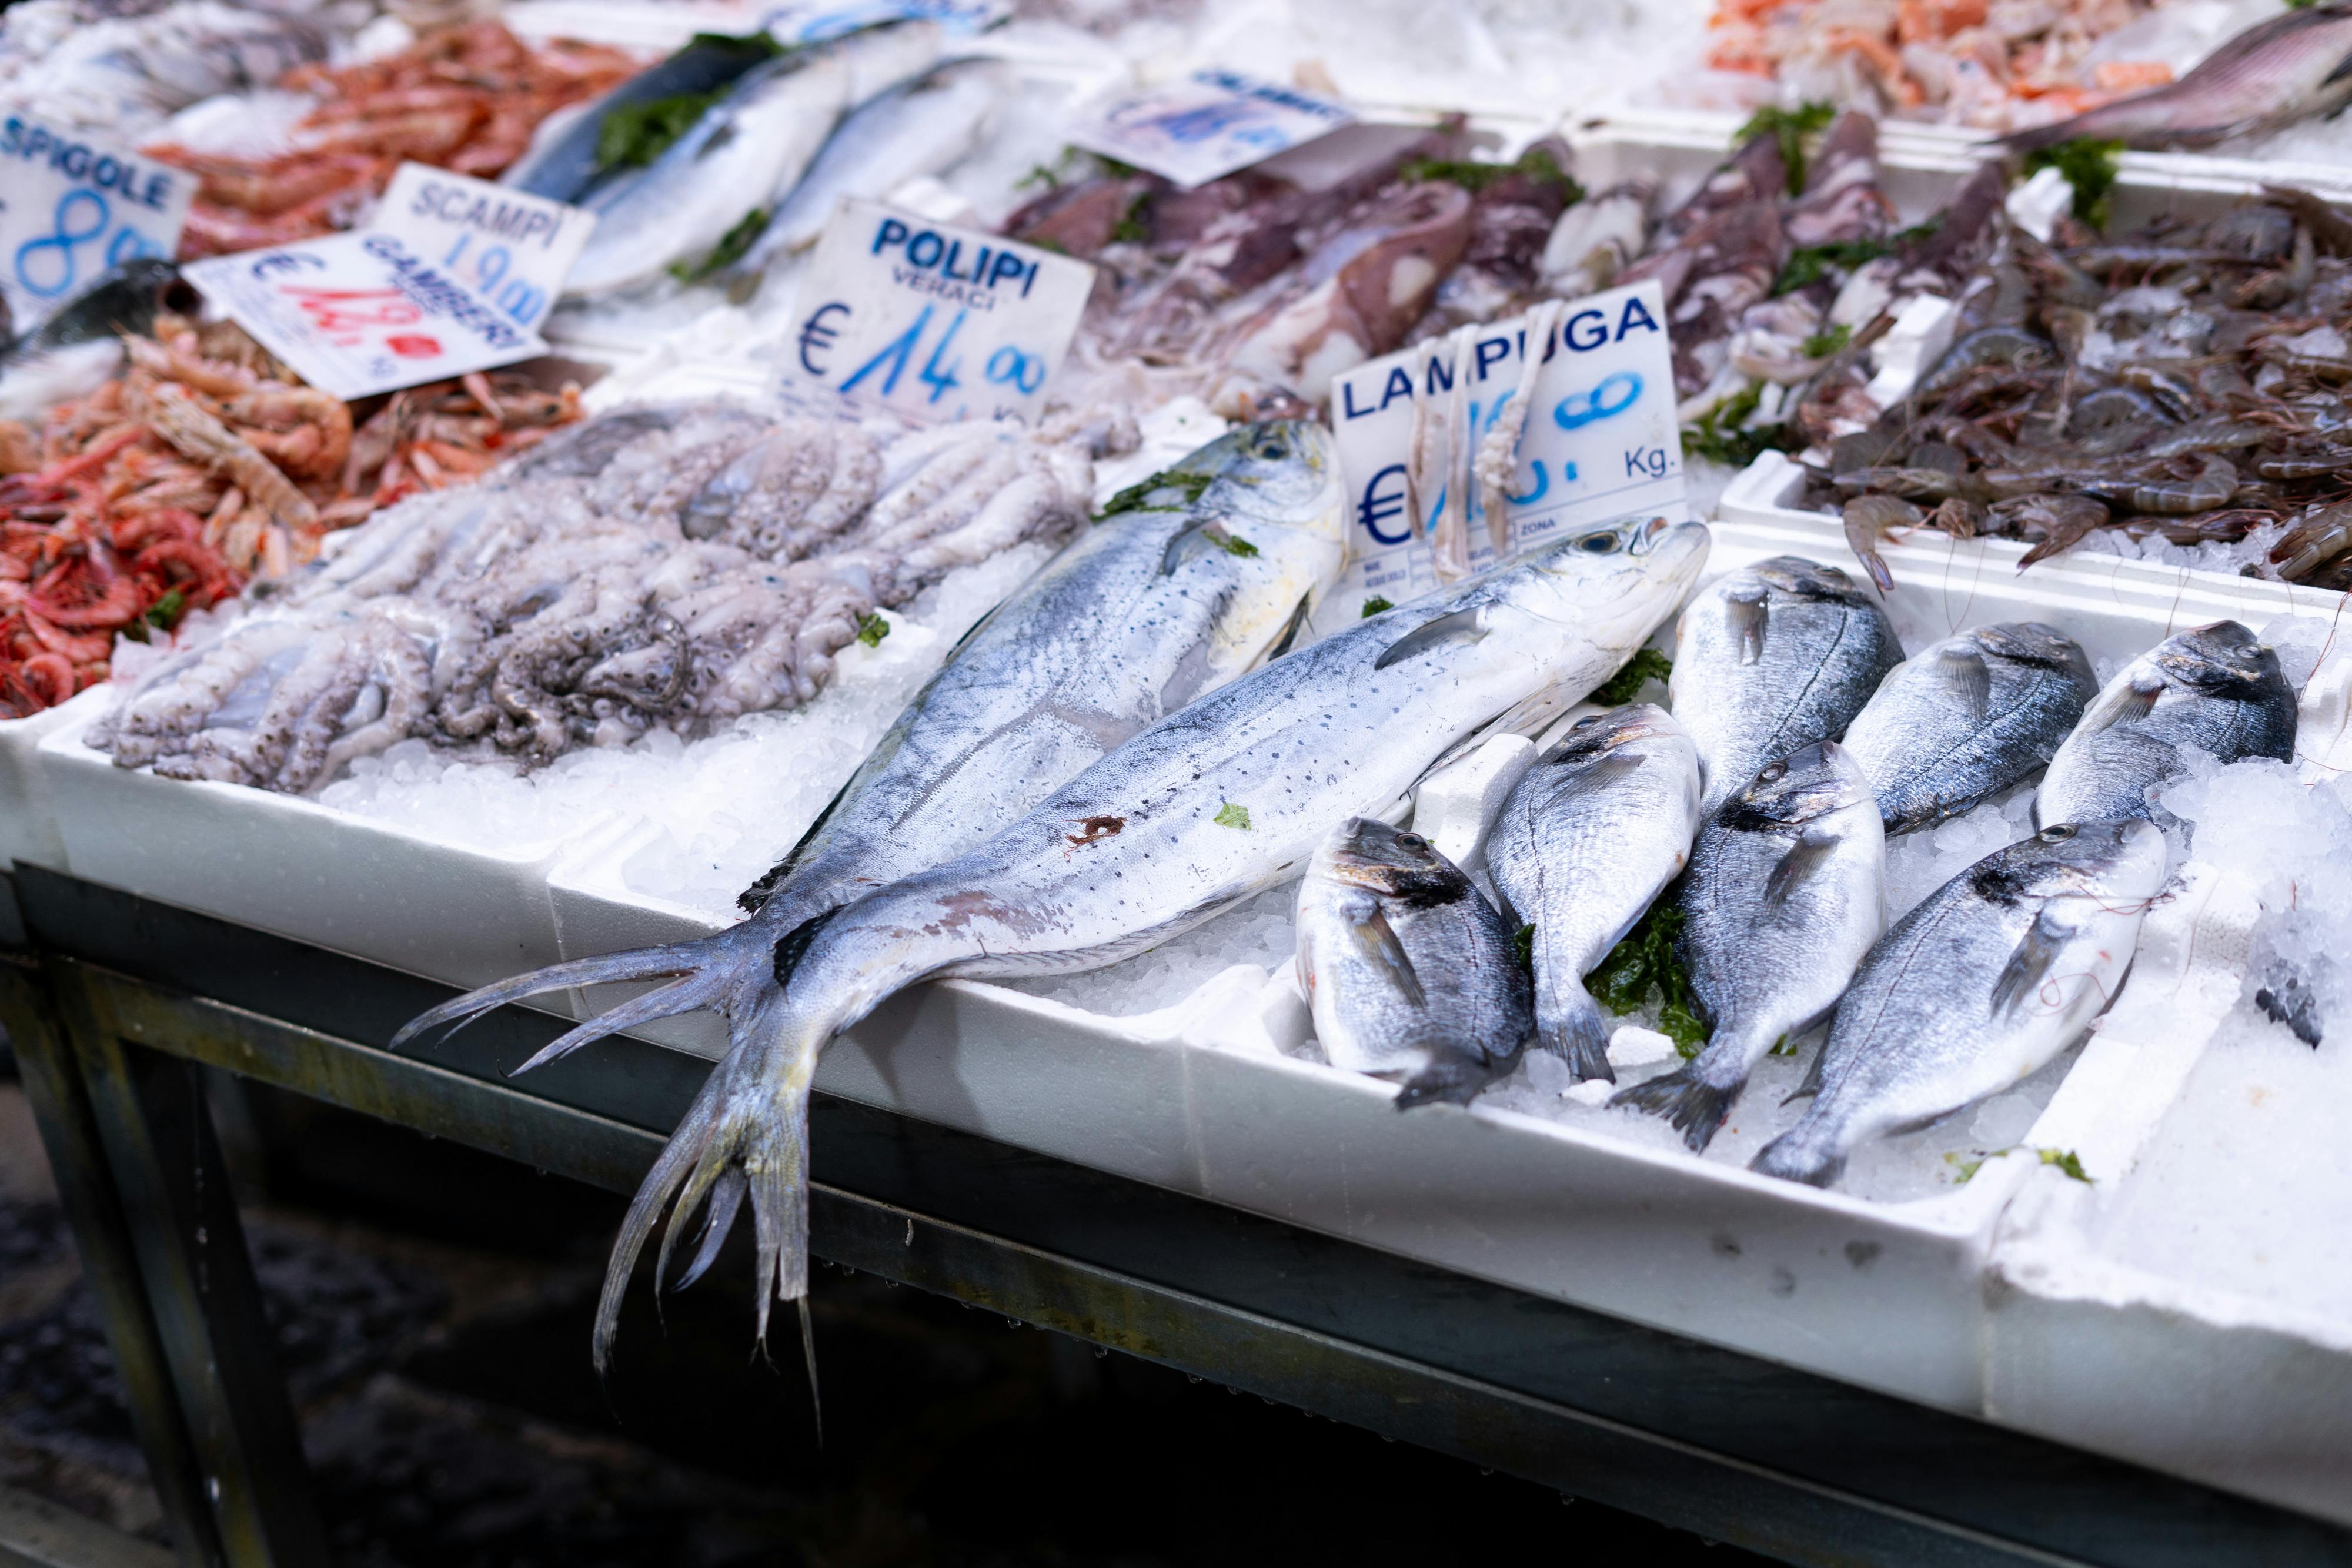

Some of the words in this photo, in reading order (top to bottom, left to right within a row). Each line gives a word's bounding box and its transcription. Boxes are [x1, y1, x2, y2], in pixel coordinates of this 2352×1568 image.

[0, 118, 174, 212] SPIGOLE
[412, 181, 562, 249] SCAMPI
[871, 218, 1039, 299] POLIPI
[892, 265, 996, 312] VERACI
[796, 302, 851, 376] €
[1357, 463, 1412, 545] €
[1521, 518, 1556, 536] ZONA
